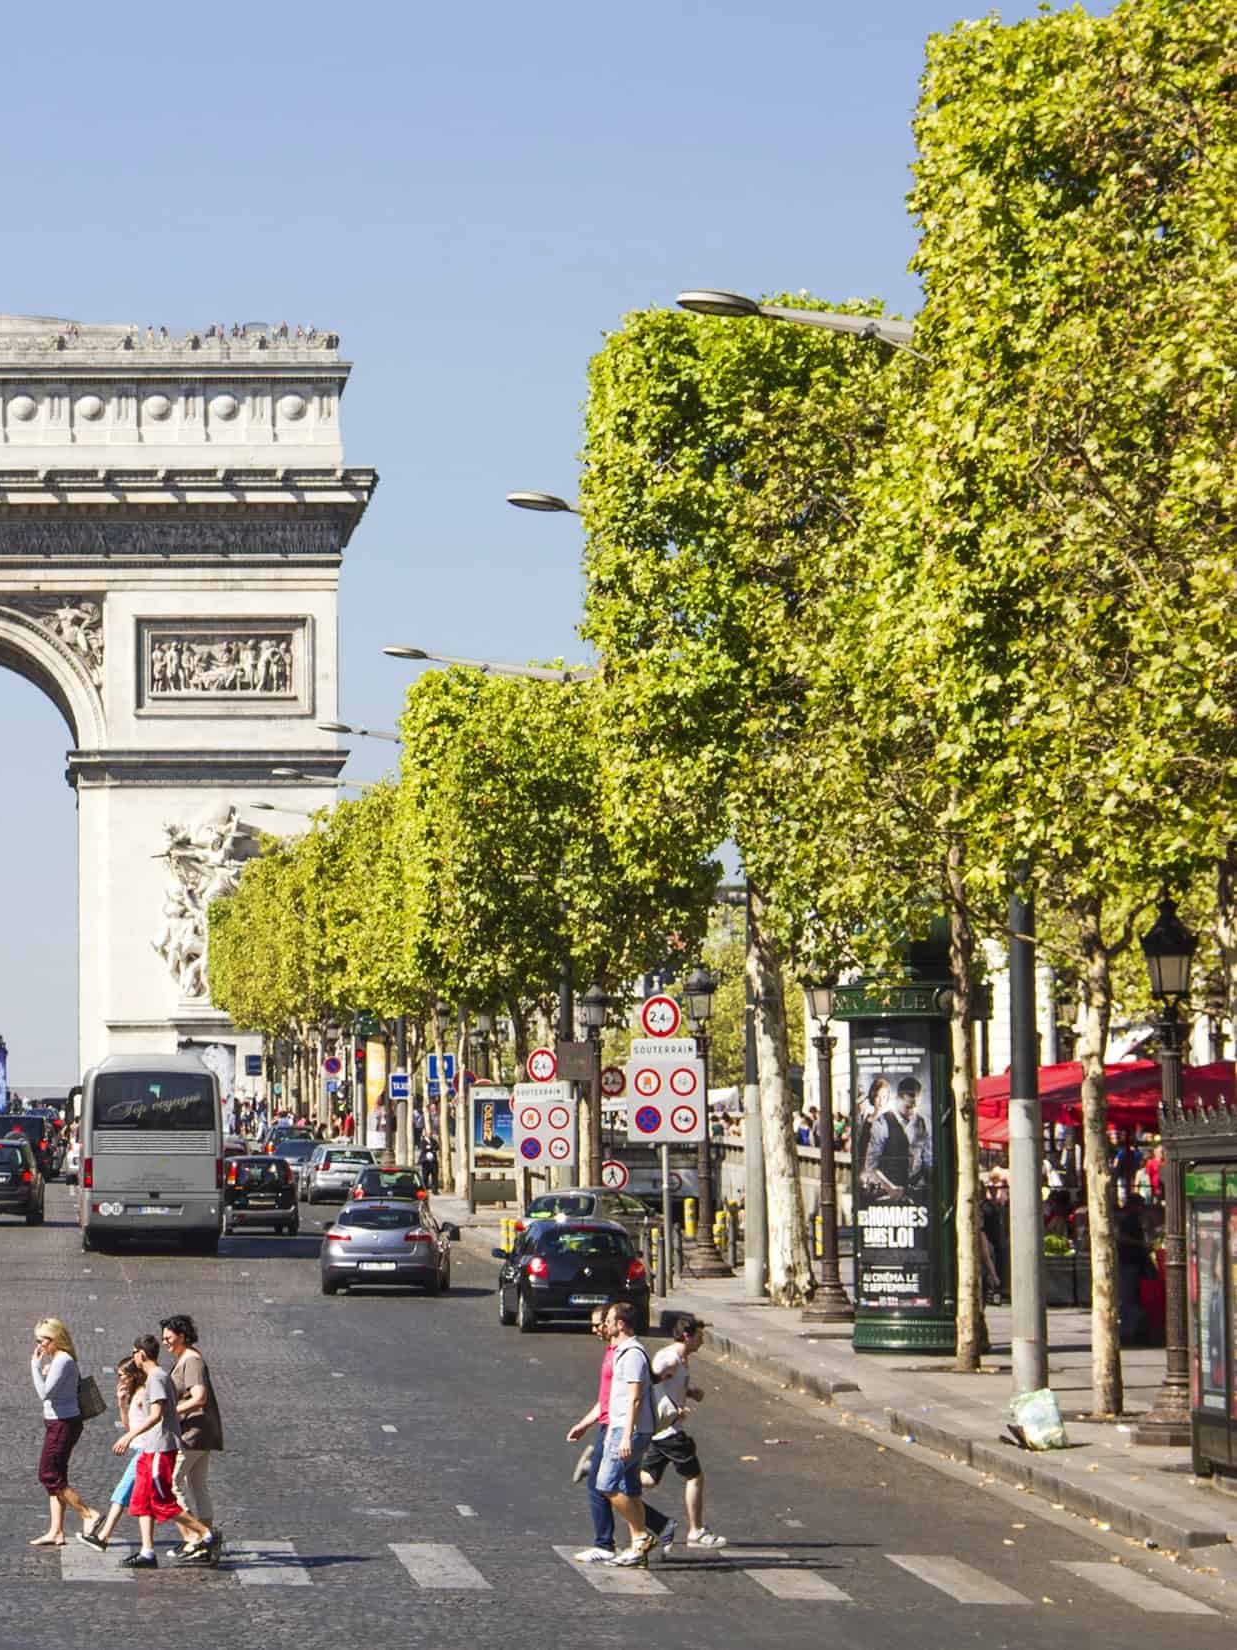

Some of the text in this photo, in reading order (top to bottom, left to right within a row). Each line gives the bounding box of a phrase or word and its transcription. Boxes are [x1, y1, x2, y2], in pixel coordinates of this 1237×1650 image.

[633, 1044, 693, 1055] SOUTERRAIN
[867, 1205, 929, 1228] HOMMES
[863, 1226, 915, 1248] SANS LOI
[872, 1271, 905, 1283] CINÉMA
[906, 1273, 919, 1282] LE
[869, 1283, 919, 1293] SEPTEMBRE
